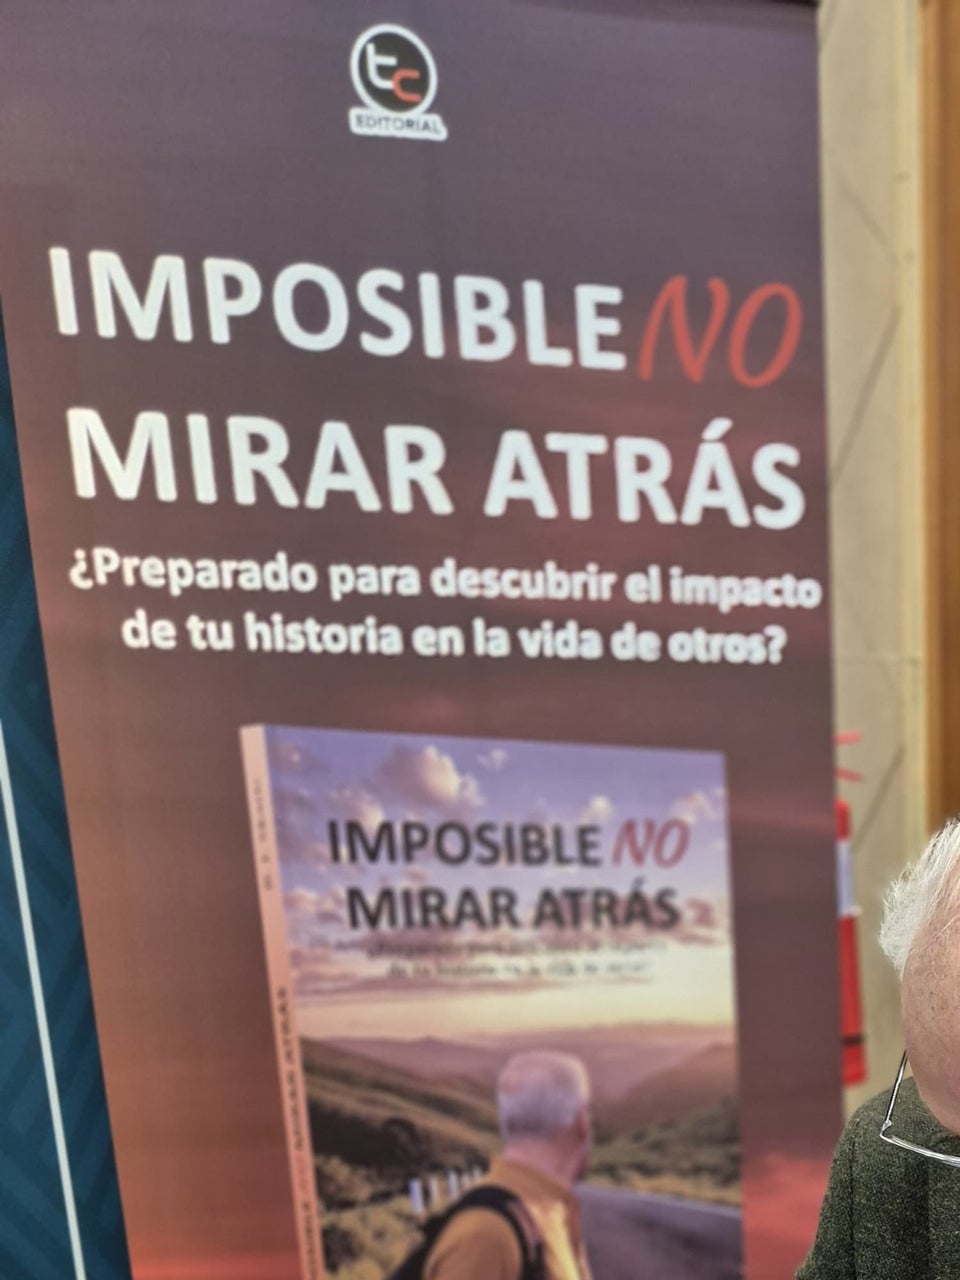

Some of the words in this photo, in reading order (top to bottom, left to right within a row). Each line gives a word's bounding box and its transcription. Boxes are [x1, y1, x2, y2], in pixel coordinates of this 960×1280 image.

[355, 114, 442, 135] EDITORIAL
[48, 246, 627, 371] IMPOSIBLE
[638, 276, 802, 387] NO
[67, 408, 454, 516] MIRAR
[484, 418, 805, 531] ATRÁS
[69, 548, 317, 595] ¿Preparado
[330, 560, 421, 601] para
[430, 559, 617, 602] descubrir
[624, 567, 663, 602] el
[670, 568, 821, 613] impacto
[122, 610, 176, 648] de
[186, 615, 234, 650] tu
[243, 613, 403, 655] historia
[413, 624, 464, 657] en
[474, 619, 510, 657] la
[519, 622, 602, 659] vida
[610, 623, 660, 661] de
[668, 624, 786, 663] otros?
[329, 819, 602, 867] IMPOSIBLE
[612, 818, 690, 869] NO
[348, 886, 520, 929] MIRAR
[533, 875, 681, 929] ATRÁS
